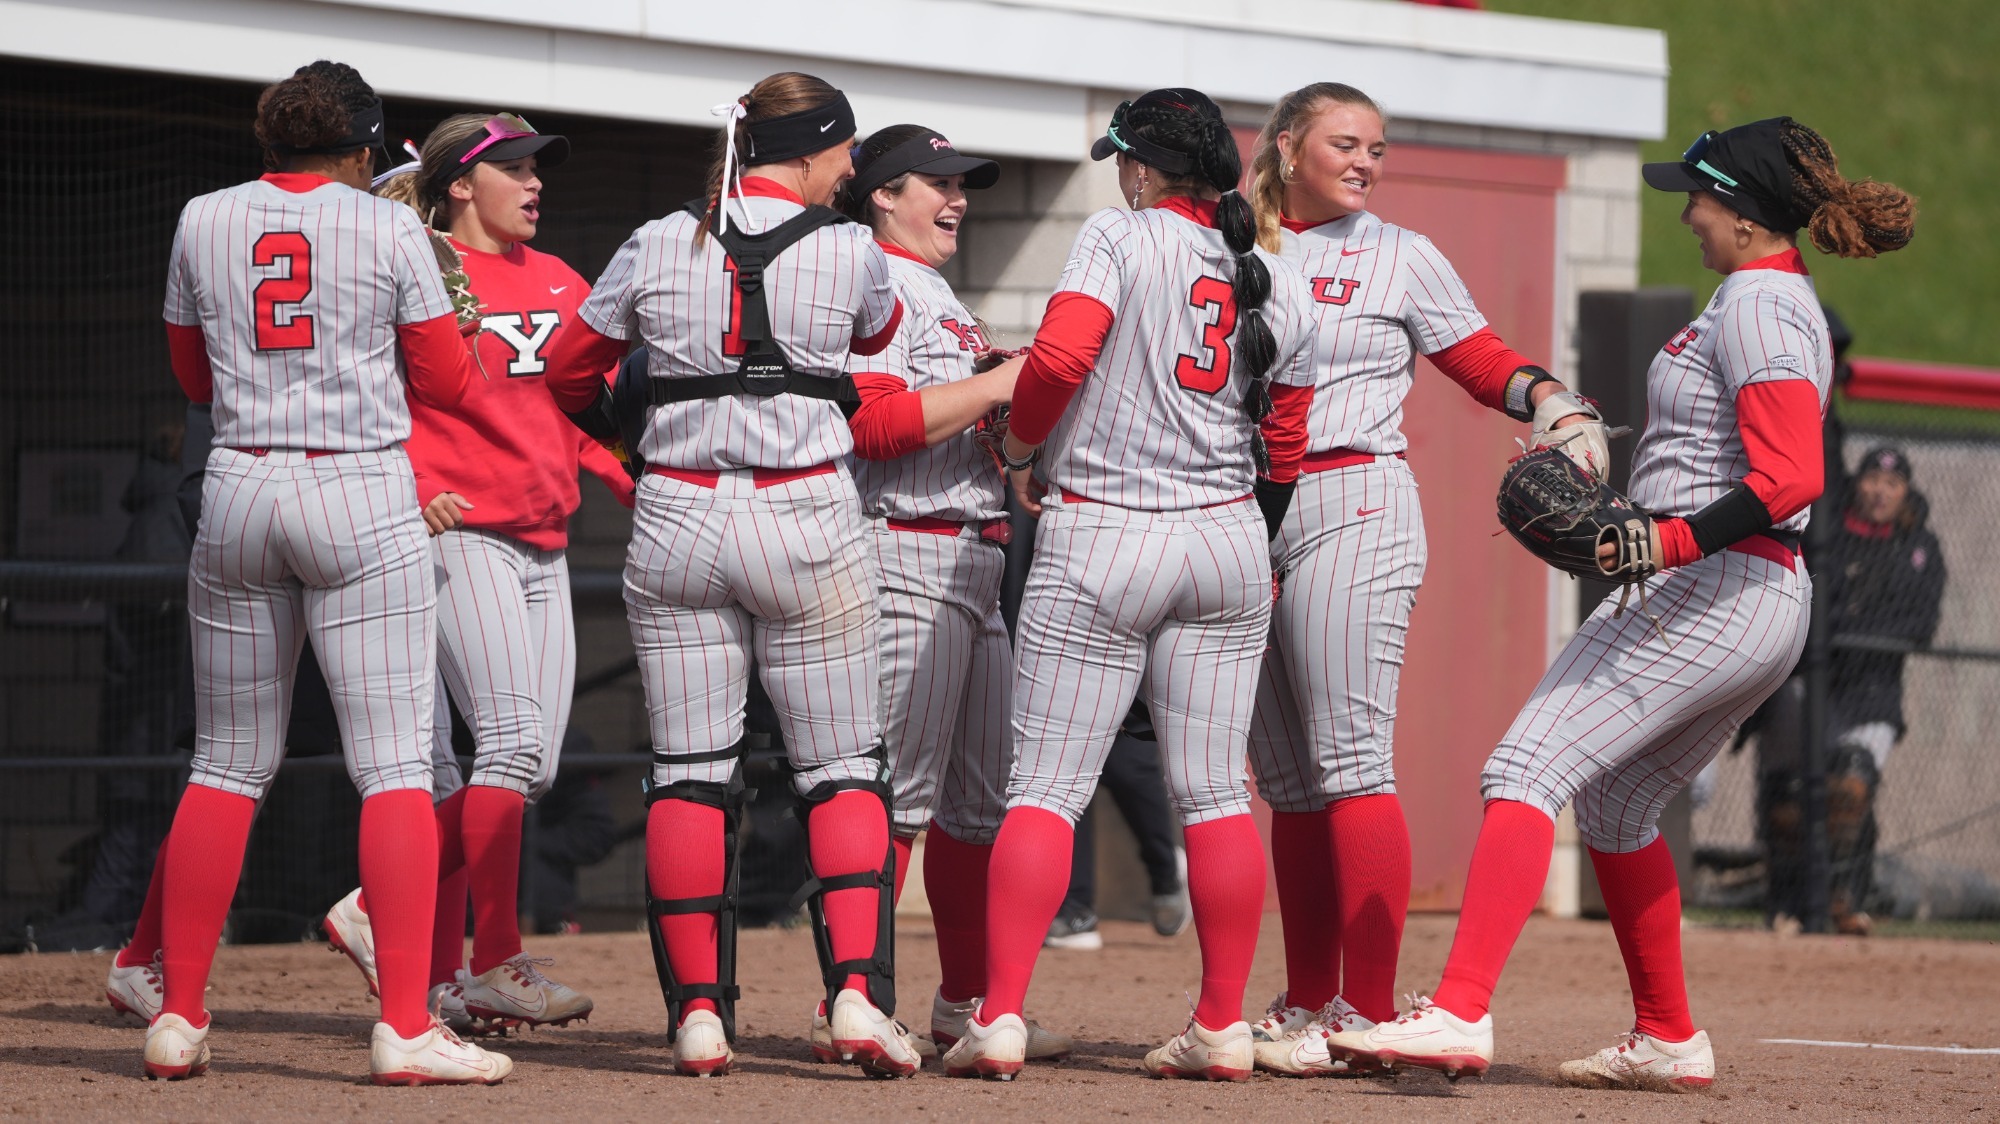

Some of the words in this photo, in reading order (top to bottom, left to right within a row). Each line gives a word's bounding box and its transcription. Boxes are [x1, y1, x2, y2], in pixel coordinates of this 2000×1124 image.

[252, 231, 314, 351] 2
[480, 310, 562, 378] Y
[1174, 275, 1239, 396] 3
